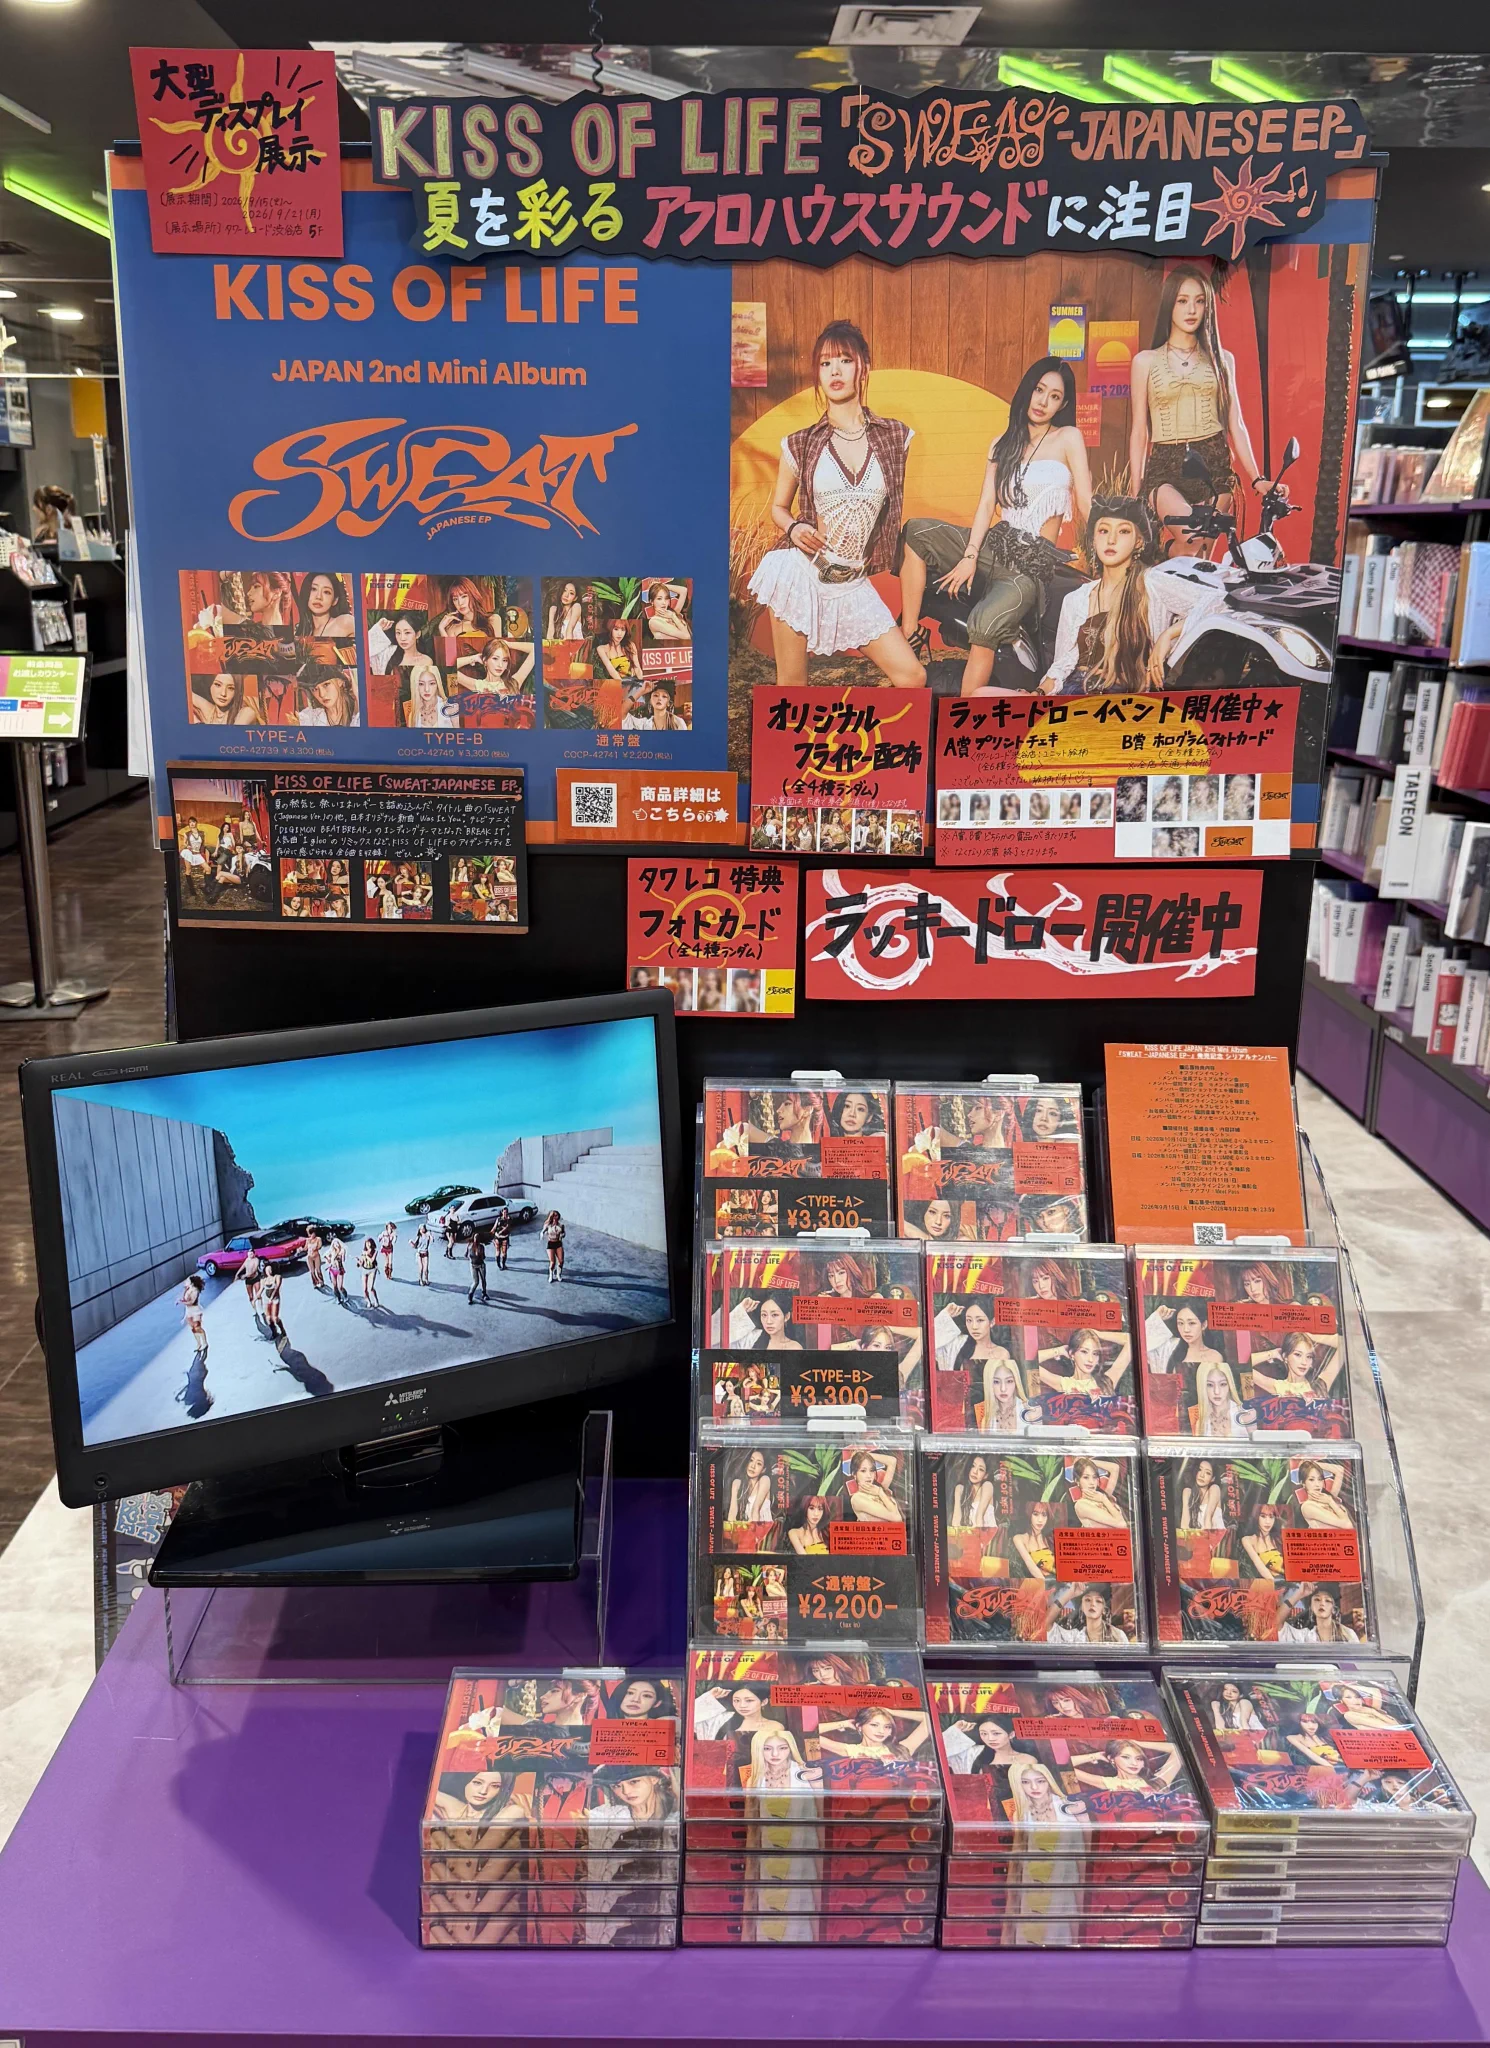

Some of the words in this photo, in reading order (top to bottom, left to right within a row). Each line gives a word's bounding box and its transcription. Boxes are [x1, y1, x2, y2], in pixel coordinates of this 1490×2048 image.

[150, 59, 216, 102] 大型
[194, 91, 306, 133] ディスプレイ
[377, 103, 542, 179] KISS
[571, 102, 656, 178] OF
[681, 97, 823, 176] LIFE
[255, 135, 320, 174] 展示
[213, 264, 375, 321] KISS
[392, 265, 486, 322] OF
[505, 266, 639, 324] LIFE
[1051, 306, 1083, 316] SUMMER
[272, 359, 363, 383] JAPAN
[369, 359, 421, 384] 2nd
[428, 359, 488, 384] Mini
[493, 361, 587, 386] Album
[228, 418, 639, 542] SWEAT
[426, 514, 477, 541] JAPANESE
[477, 515, 492, 524] EP
[664, 651, 676, 665] OF
[768, 698, 880, 735] オリジナル
[245, 731, 307, 743] TYPE-A
[424, 733, 483, 745] TYPE-B
[596, 735, 640, 747] 通常盤
[1122, 733, 1146, 750] B賞
[1153, 729, 1274, 748] ホログラムフォトカード
[219, 746, 279, 755] COCP-42739
[398, 748, 454, 757] COCP-42740
[564, 751, 618, 759] COCP-42741
[794, 741, 922, 774] フライヤー配布
[274, 774, 308, 789] KISS
[313, 776, 333, 789] OF
[337, 776, 372, 790] LIFE
[782, 777, 879, 799] (全4種ランダム)
[640, 786, 721, 802] 商品詳細は
[1398, 772, 1421, 836] TAEYEON
[650, 807, 697, 823] こちら
[638, 867, 720, 894] タワレコ
[729, 866, 784, 894] 特典
[639, 906, 779, 941] フォトカード
[823, 890, 1241, 964] ラッキードロー開催中
[667, 941, 763, 962] (全4種ランダム)
[51, 1072, 84, 1083] REAL
[796, 1195, 864, 1208] <TYPE-A>
[799, 1369, 874, 1383] <TYPE-B>
[709, 1479, 716, 1488] OF
[932, 1487, 938, 1496] OF
[1160, 1490, 1166, 1498] OF
